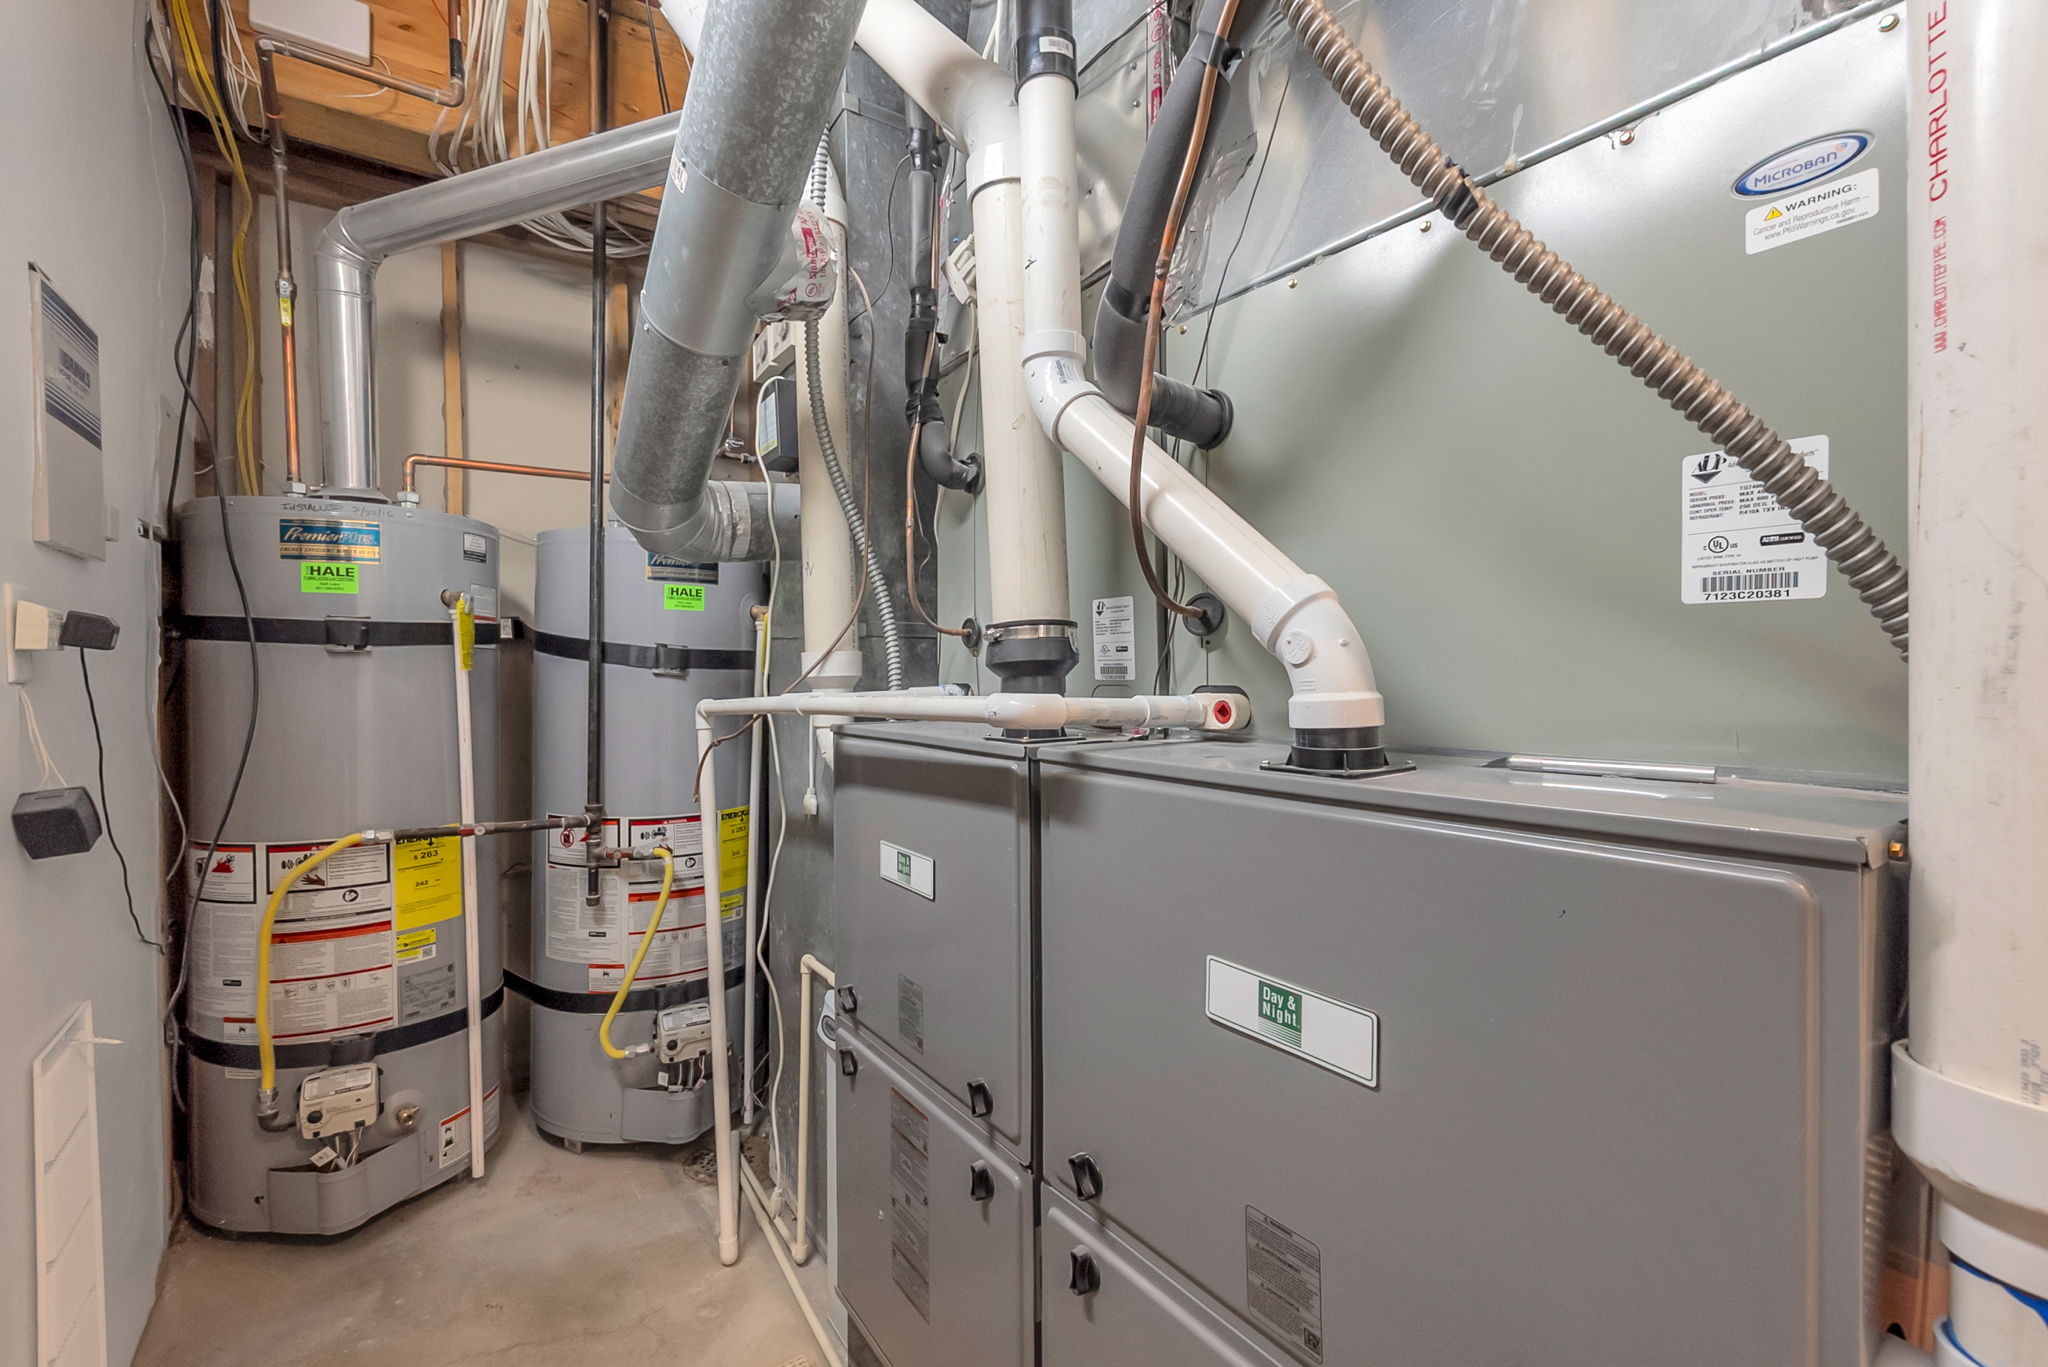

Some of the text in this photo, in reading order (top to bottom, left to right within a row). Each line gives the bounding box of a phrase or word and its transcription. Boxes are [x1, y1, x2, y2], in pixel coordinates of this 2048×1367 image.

[1928, 0, 1948, 202] CHARLOTTE
[1754, 151, 1838, 187] MICROBAN
[1786, 183, 1857, 212] WARNING:
[1753, 223, 1777, 236] Cancer
[1778, 218, 1791, 228] and
[1793, 204, 1839, 224] Reproductive
[310, 565, 355, 577] HALE
[1746, 566, 1785, 574] NUMBER
[671, 587, 703, 598] HALE
[1704, 589, 1791, 601] 7123C20381
[1263, 986, 1297, 1011] Day &
[1262, 1001, 1297, 1028] Night
